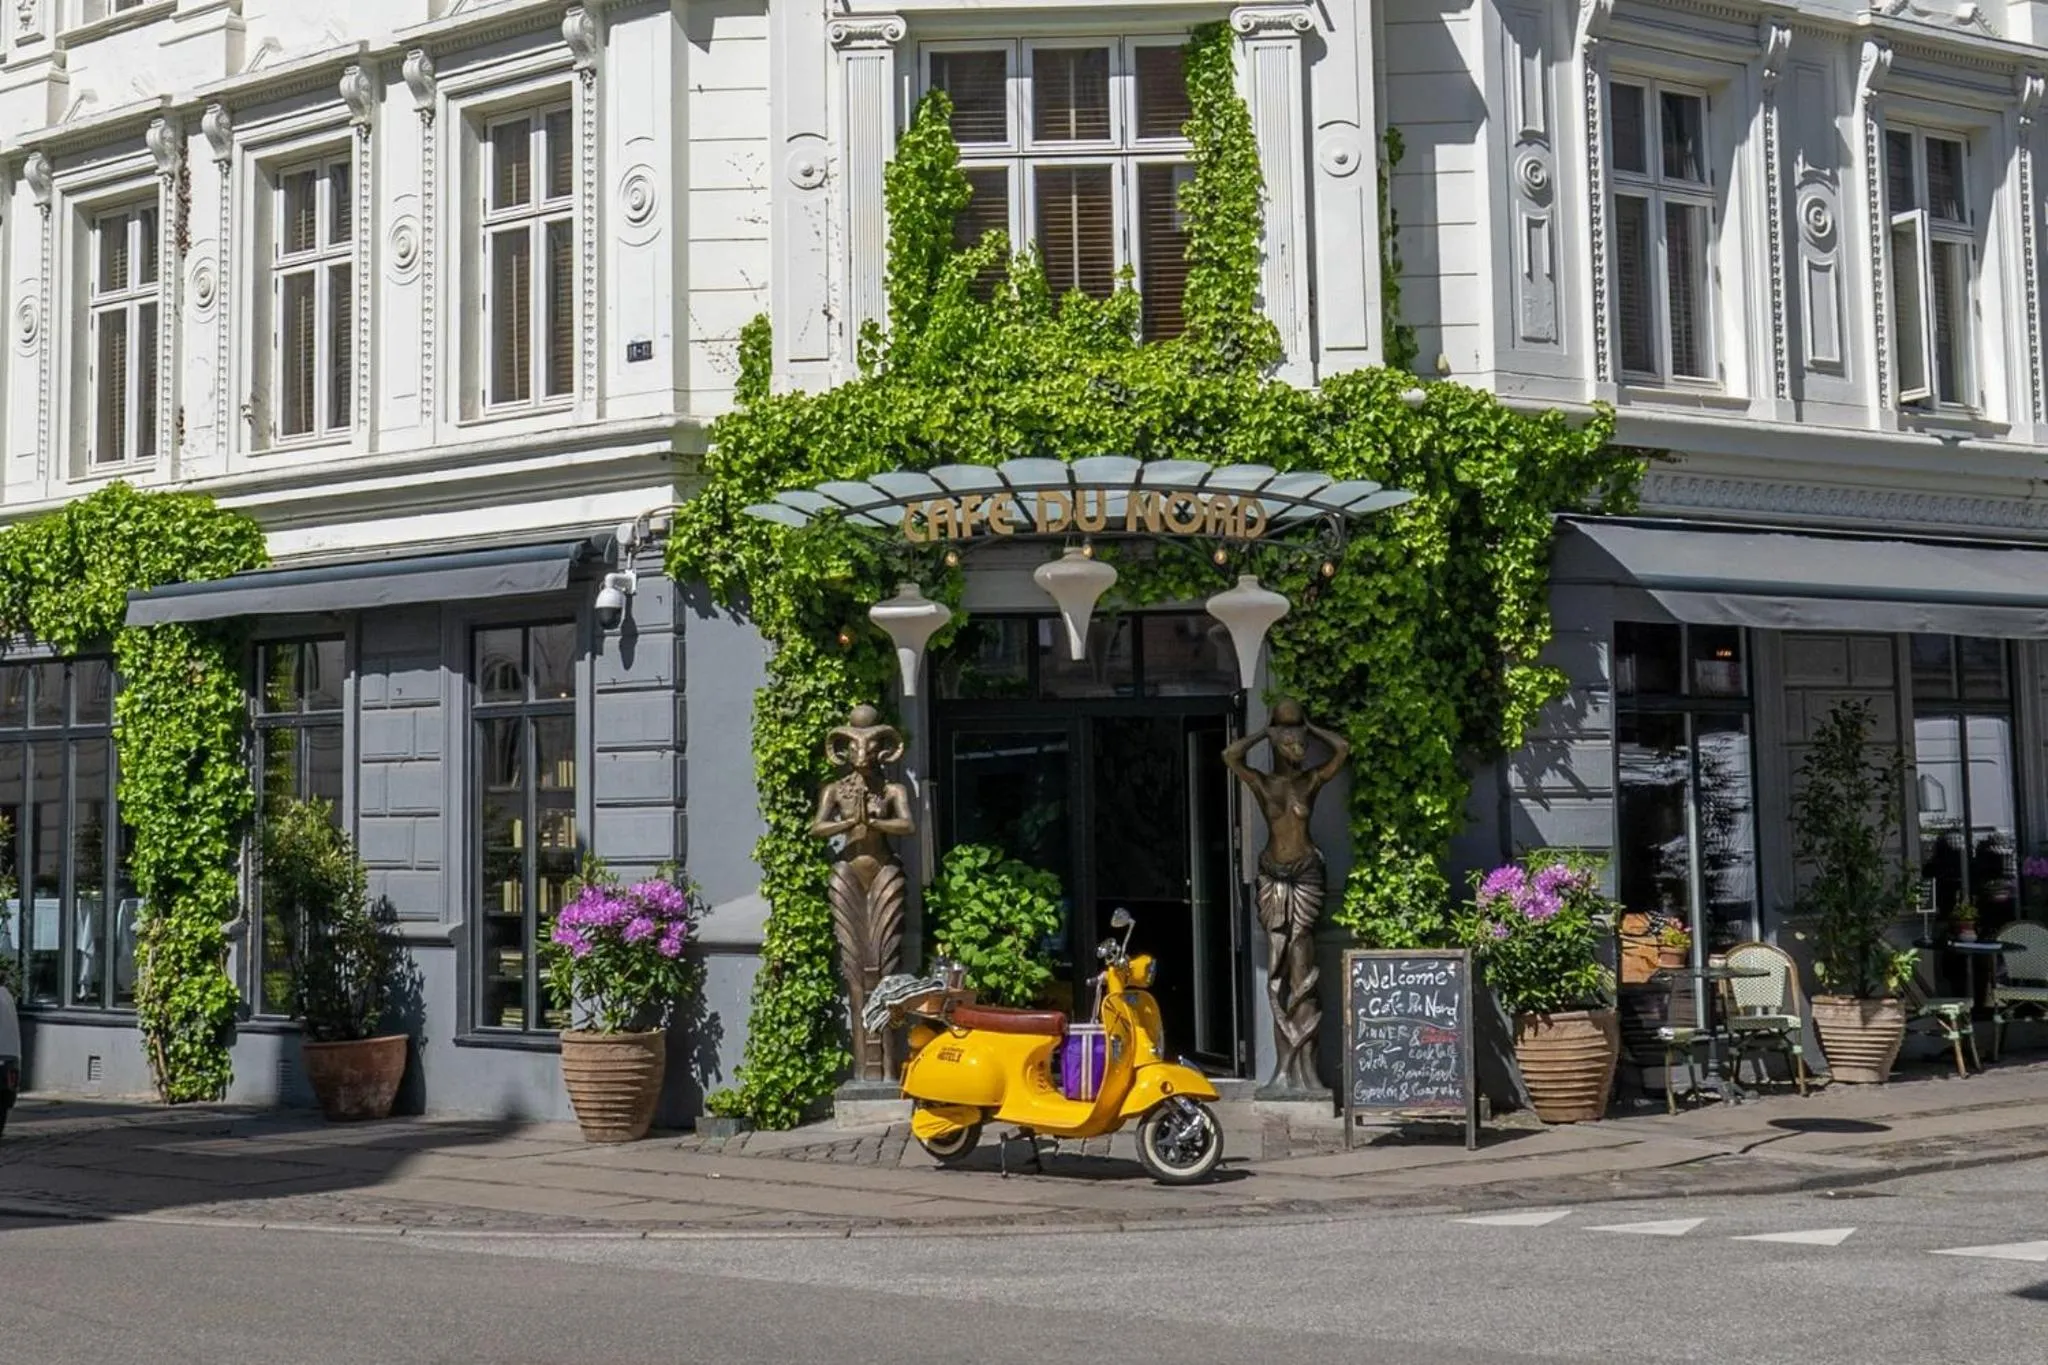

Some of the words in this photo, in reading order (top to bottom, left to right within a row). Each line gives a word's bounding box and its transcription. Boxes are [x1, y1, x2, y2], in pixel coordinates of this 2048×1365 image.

[1036, 489, 1107, 533] DU
[1125, 489, 1268, 538] NORD
[1354, 963, 1449, 991] Welcome
[1425, 990, 1459, 1022] Nord
